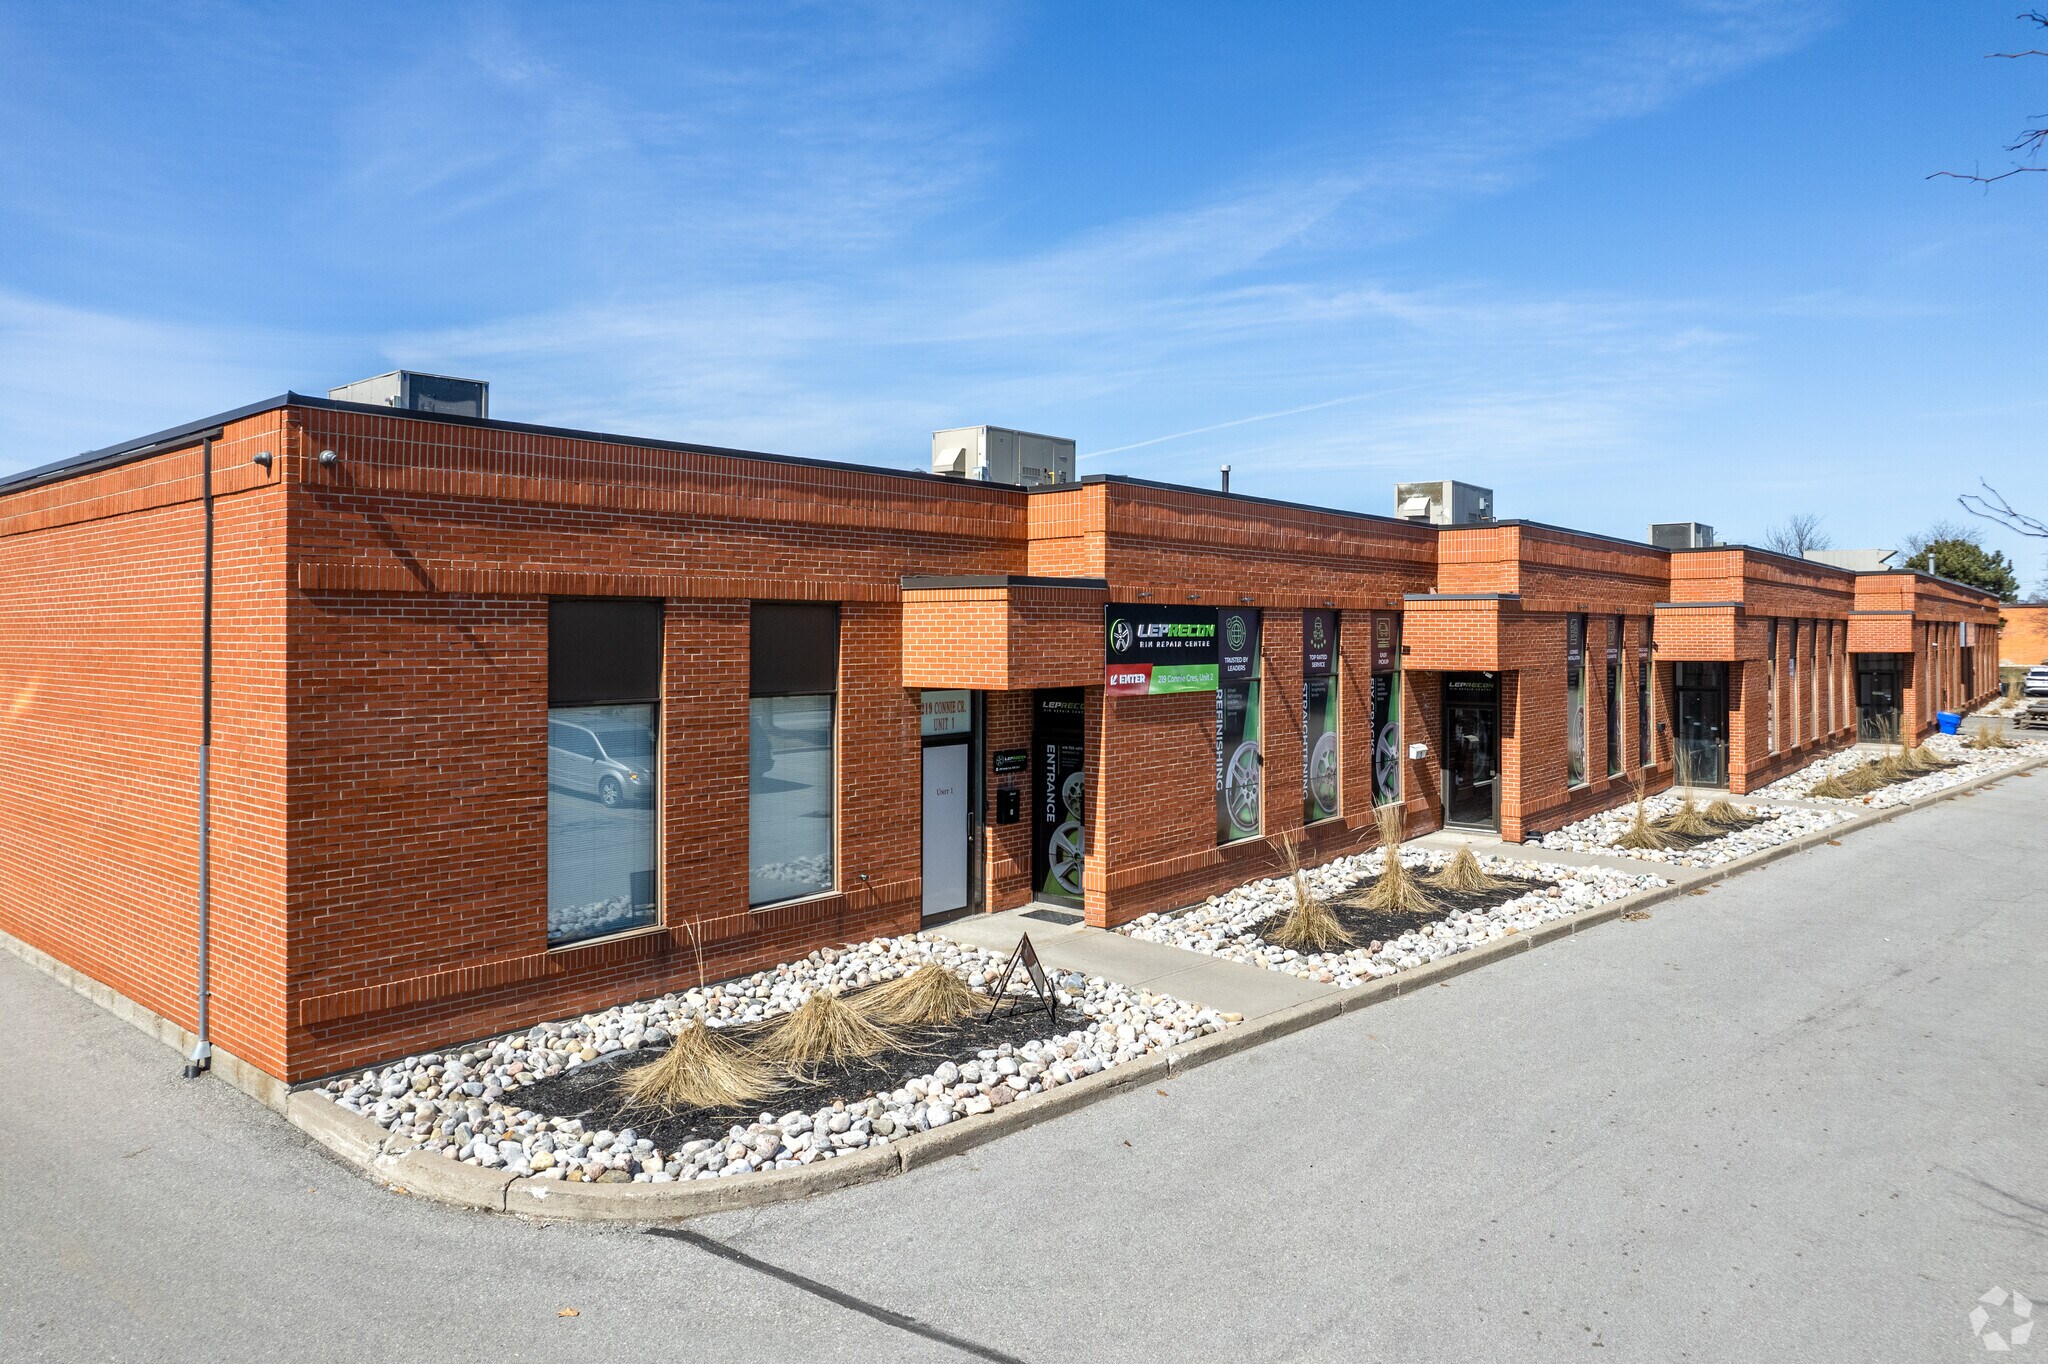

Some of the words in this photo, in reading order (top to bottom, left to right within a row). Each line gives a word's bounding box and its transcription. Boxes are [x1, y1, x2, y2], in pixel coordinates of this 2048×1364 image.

[1137, 624, 1216, 638] LEPRECON
[1140, 640, 1153, 648] RIM
[1156, 640, 1182, 648] REPAIR
[1120, 673, 1146, 684] ENTER
[1158, 675, 1166, 683] 219
[1167, 674, 1186, 683] Connie
[1199, 673, 1210, 682] Unit
[921, 702, 932, 715] 219
[934, 701, 955, 714] CONNIE
[934, 718, 948, 731] UNIT
[952, 717, 954, 729] 1
[1046, 744, 1055, 822] ENTRANCE
